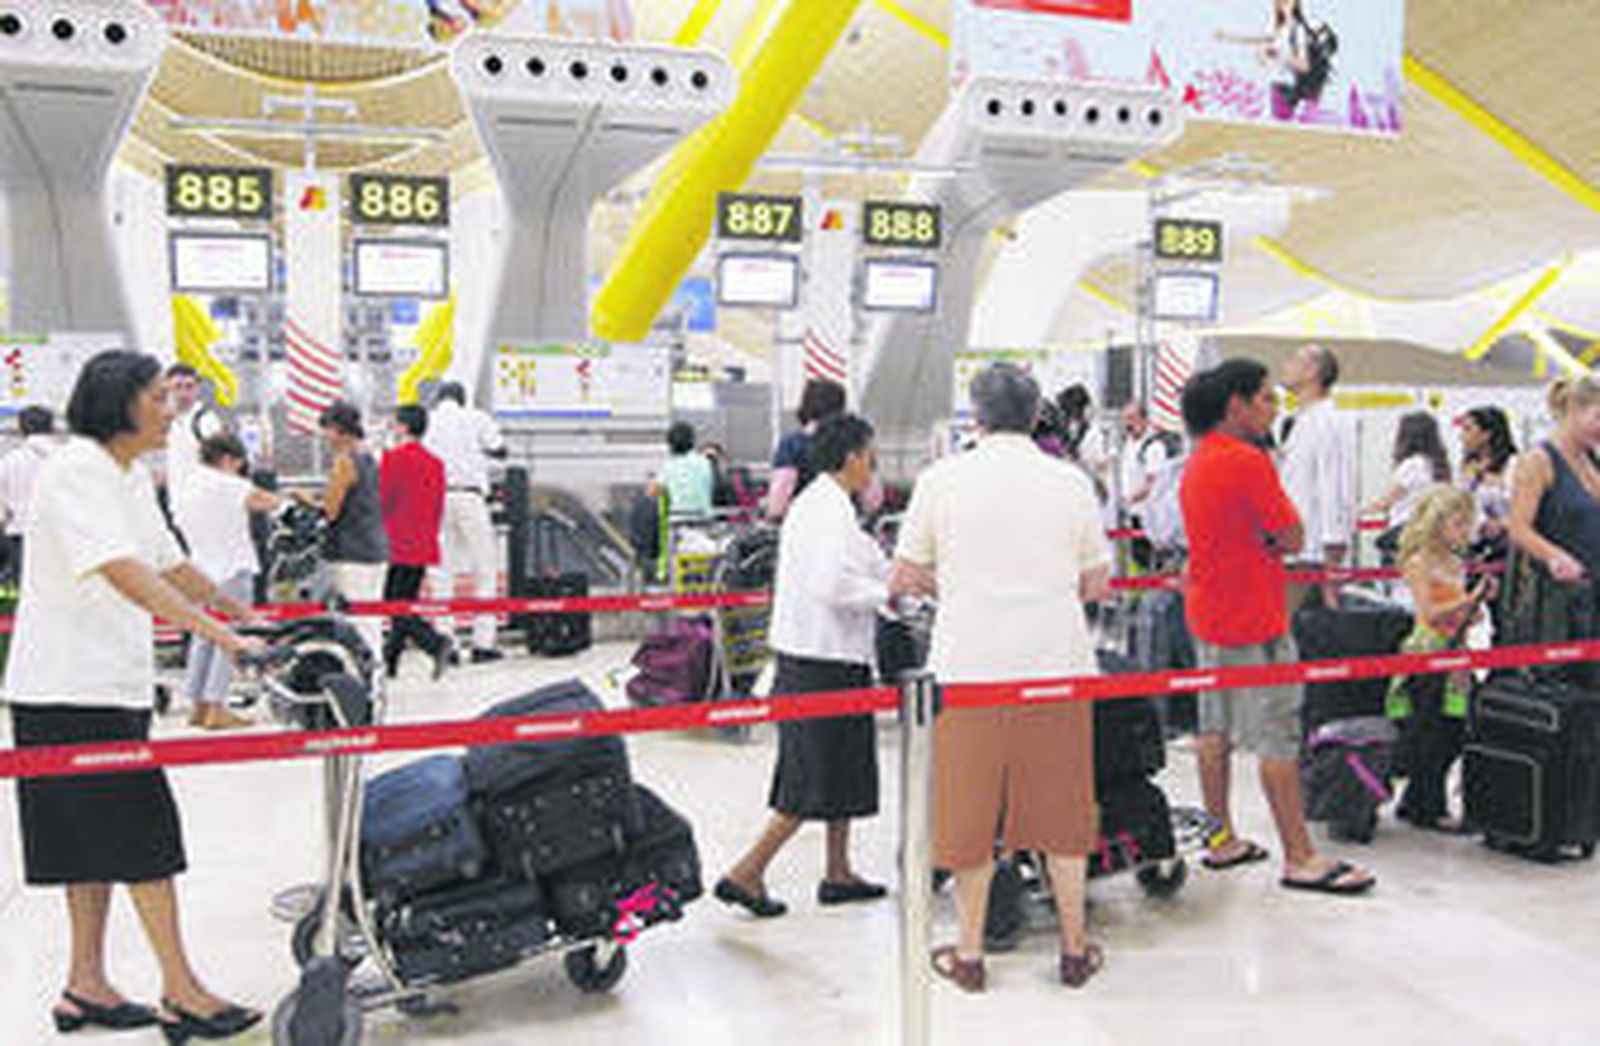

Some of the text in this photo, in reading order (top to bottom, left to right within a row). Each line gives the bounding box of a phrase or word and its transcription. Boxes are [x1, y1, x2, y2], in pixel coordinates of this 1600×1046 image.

[176, 173, 262, 211] 885
[360, 182, 440, 219] 886
[727, 201, 793, 235] 887
[870, 208, 935, 241] 888
